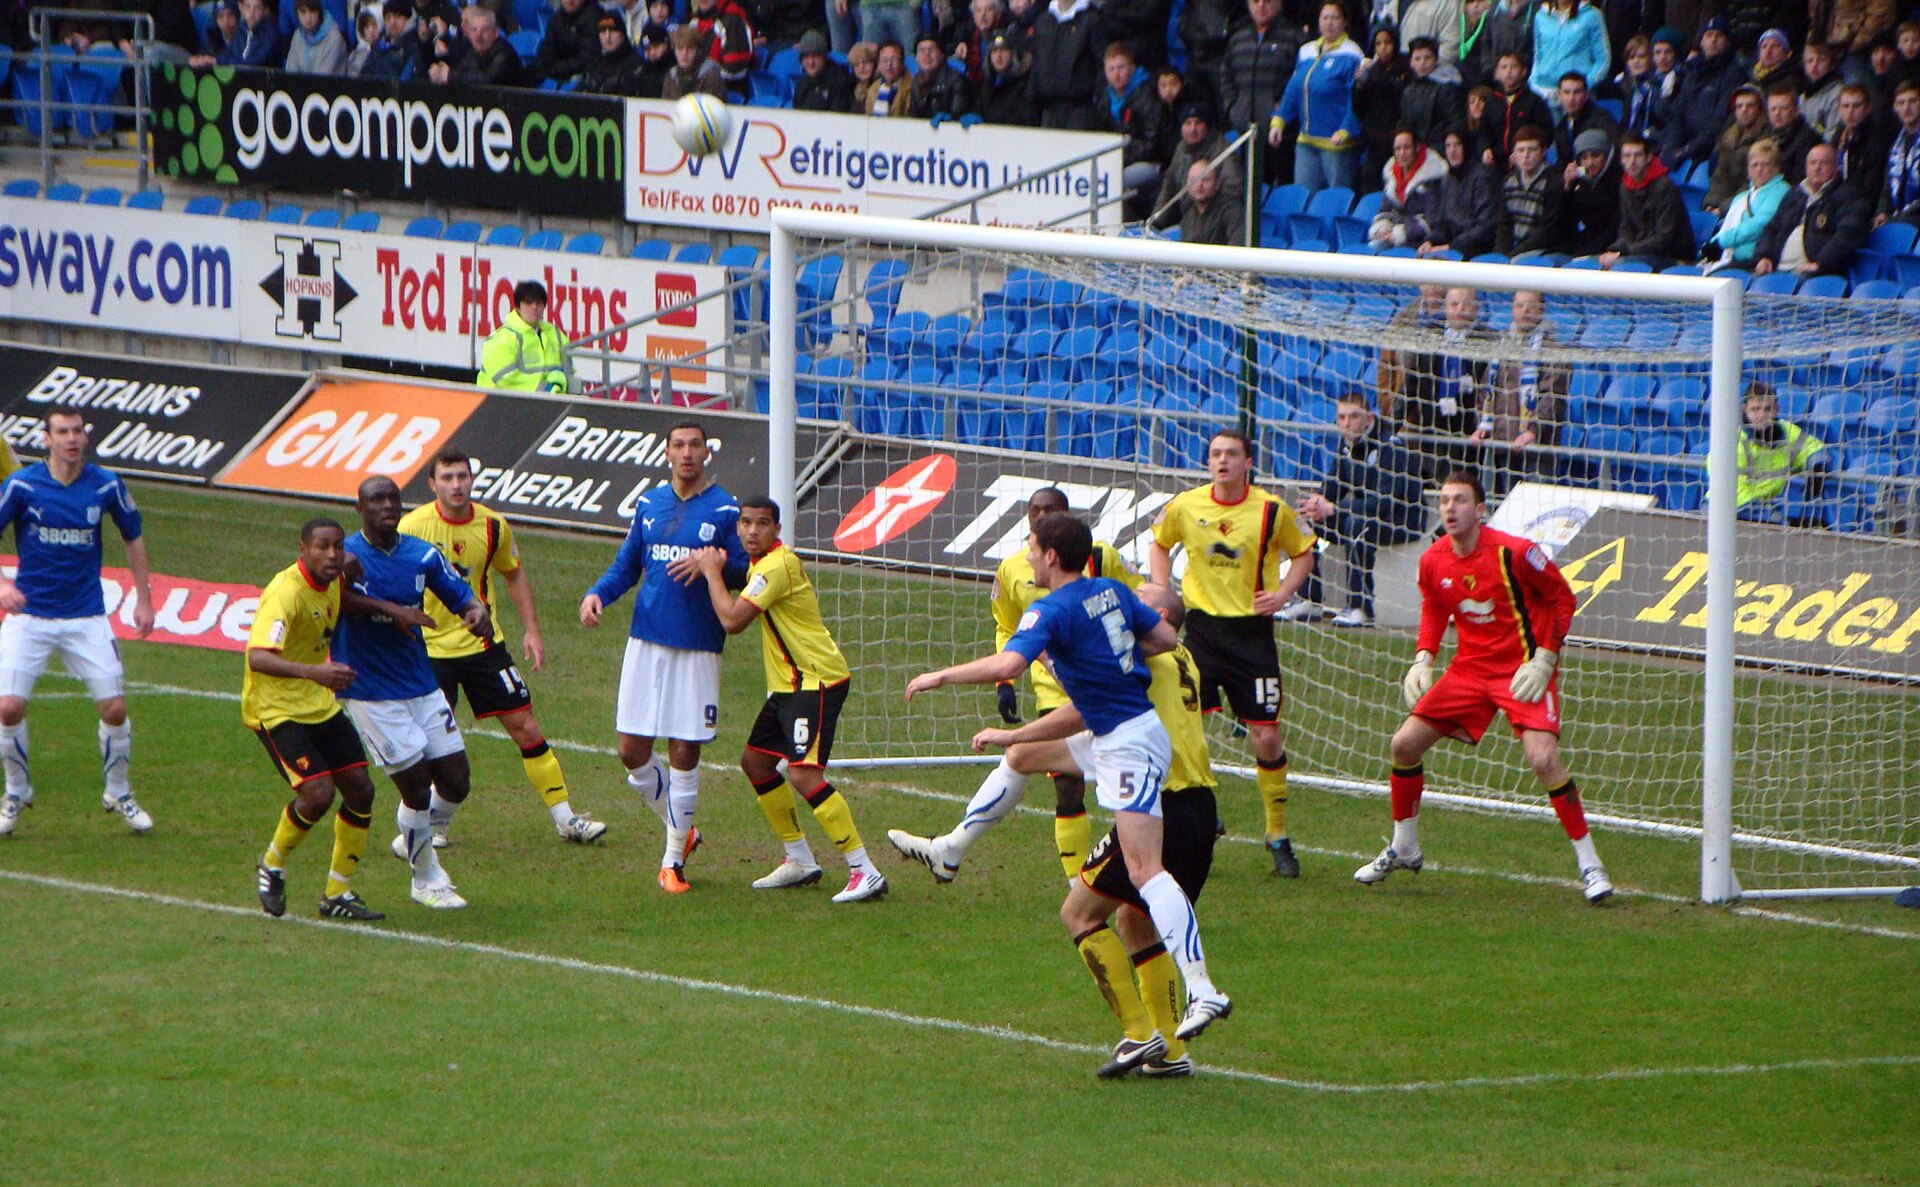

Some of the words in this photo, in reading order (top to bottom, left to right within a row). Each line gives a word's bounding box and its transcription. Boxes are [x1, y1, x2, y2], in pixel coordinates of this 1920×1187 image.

[232, 88, 622, 188] gocompare.com
[639, 187, 705, 213] Tel/Fax
[711, 193, 760, 217] 0870
[0, 224, 232, 316] sway.com
[285, 277, 332, 298] HOPKINS
[376, 247, 447, 332] Ted
[458, 256, 629, 354] Hokins
[26, 366, 201, 417] BRITAIN'S
[96, 420, 226, 470] UNION
[265, 409, 442, 476] GMB
[1101, 608, 1136, 675] 5
[1255, 677, 1281, 705] 15
[438, 707, 457, 735] 2
[704, 703, 718, 729] 9
[793, 717, 810, 745] 6
[1118, 771, 1135, 800] 5
